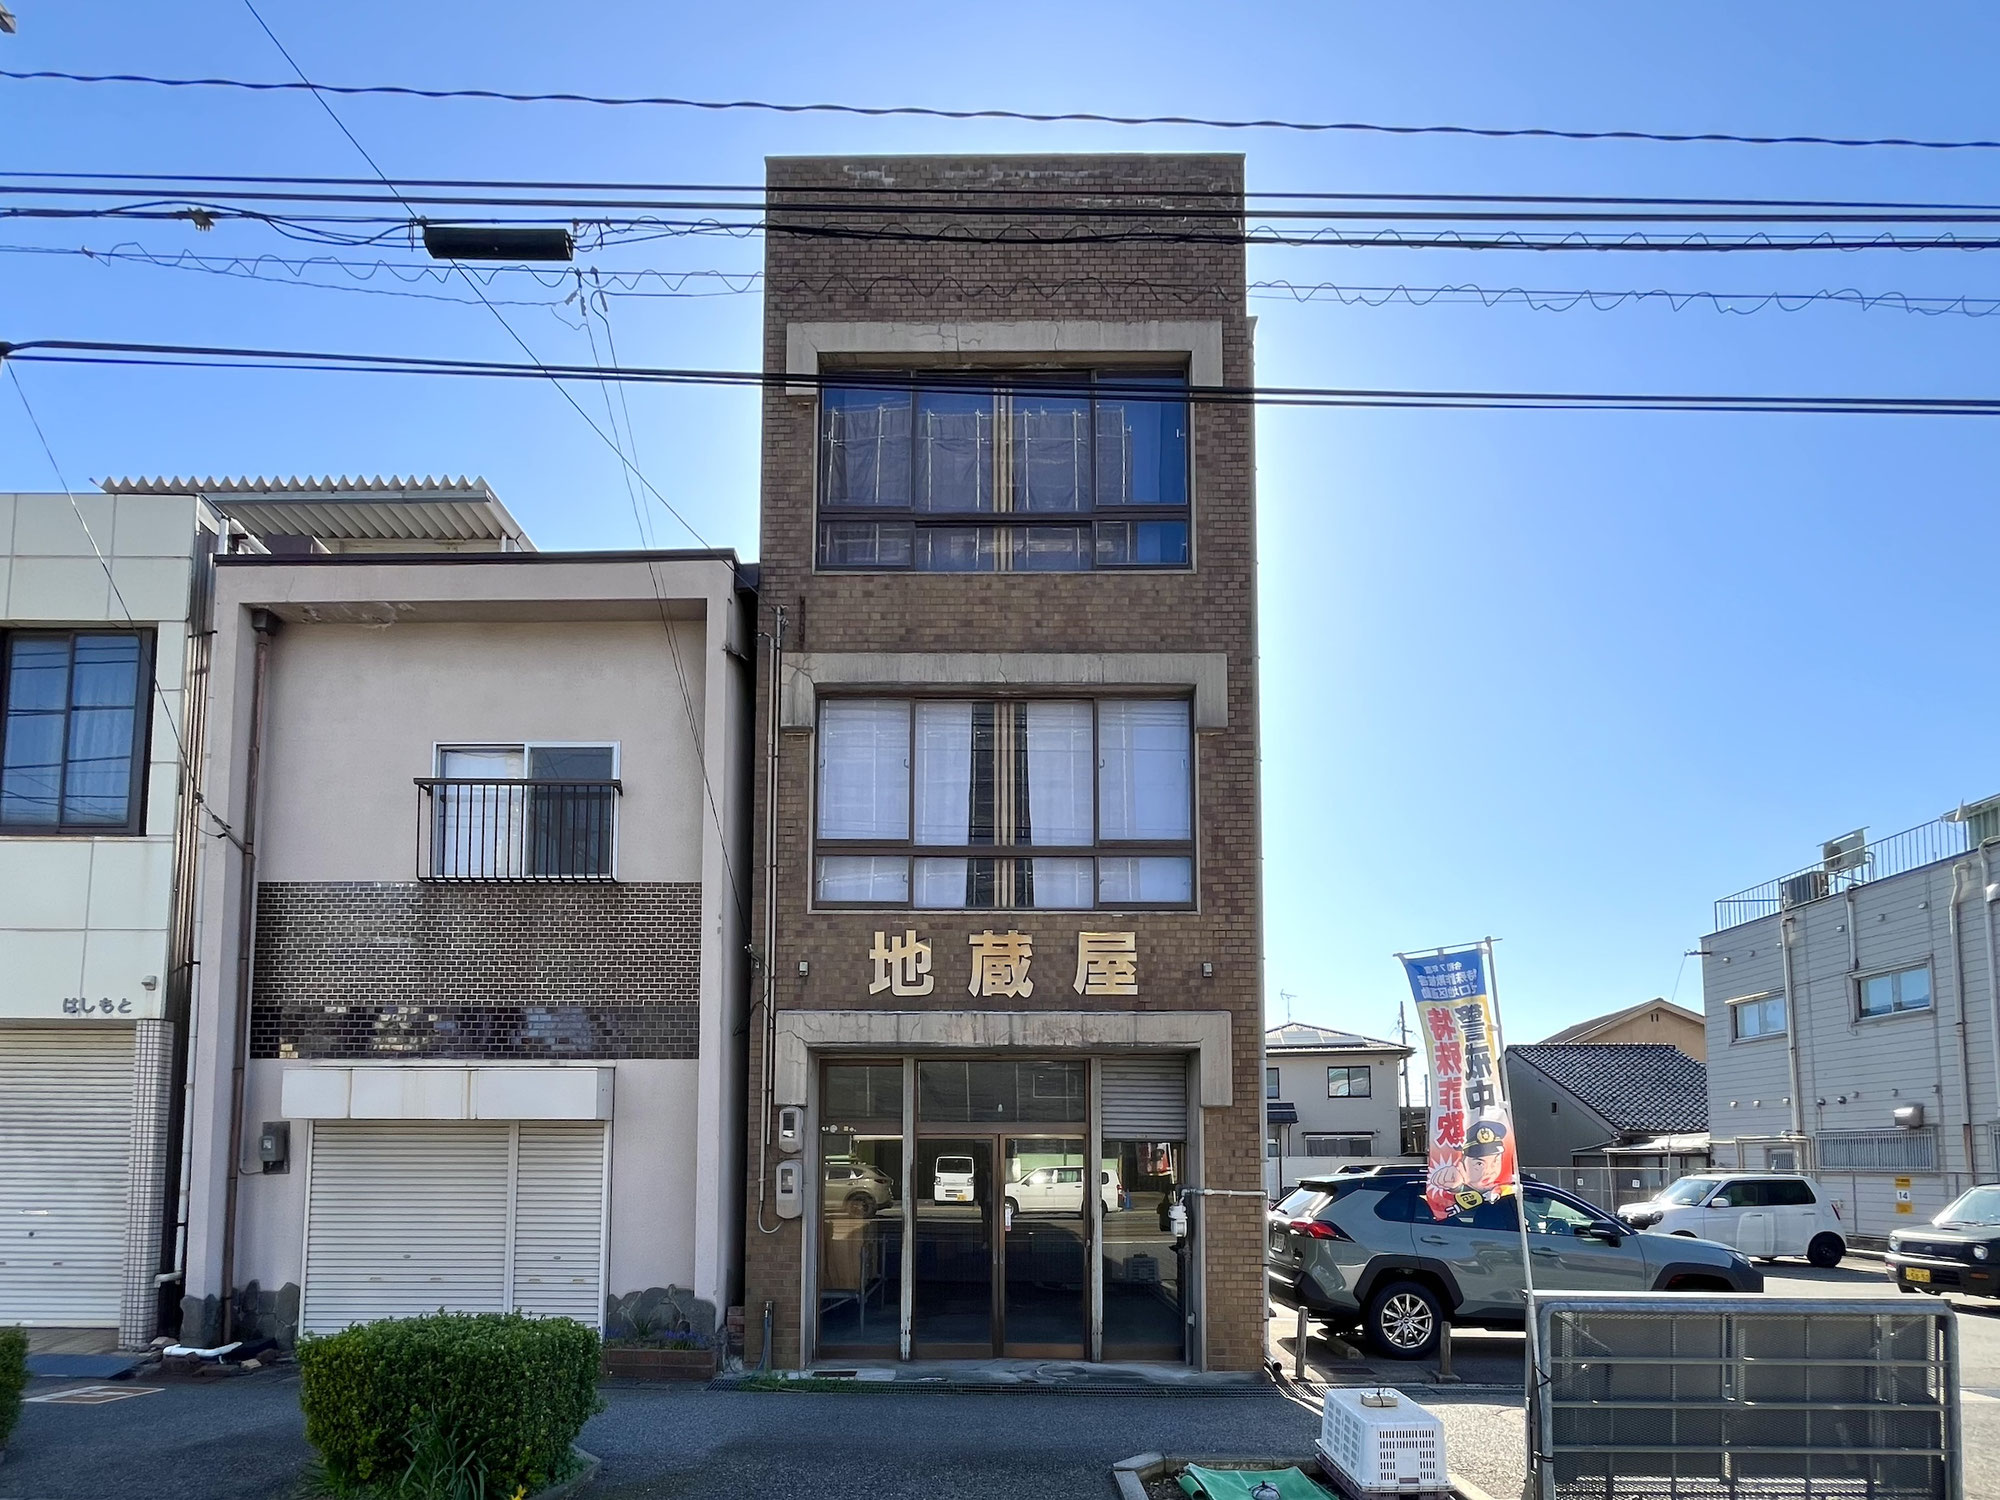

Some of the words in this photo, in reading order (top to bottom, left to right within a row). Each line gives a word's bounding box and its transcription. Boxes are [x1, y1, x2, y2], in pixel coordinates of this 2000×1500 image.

[869, 929, 1138, 998] 地蔵屋
[62, 997, 132, 1014] はしもと
[1898, 1191, 1909, 1200] 14
